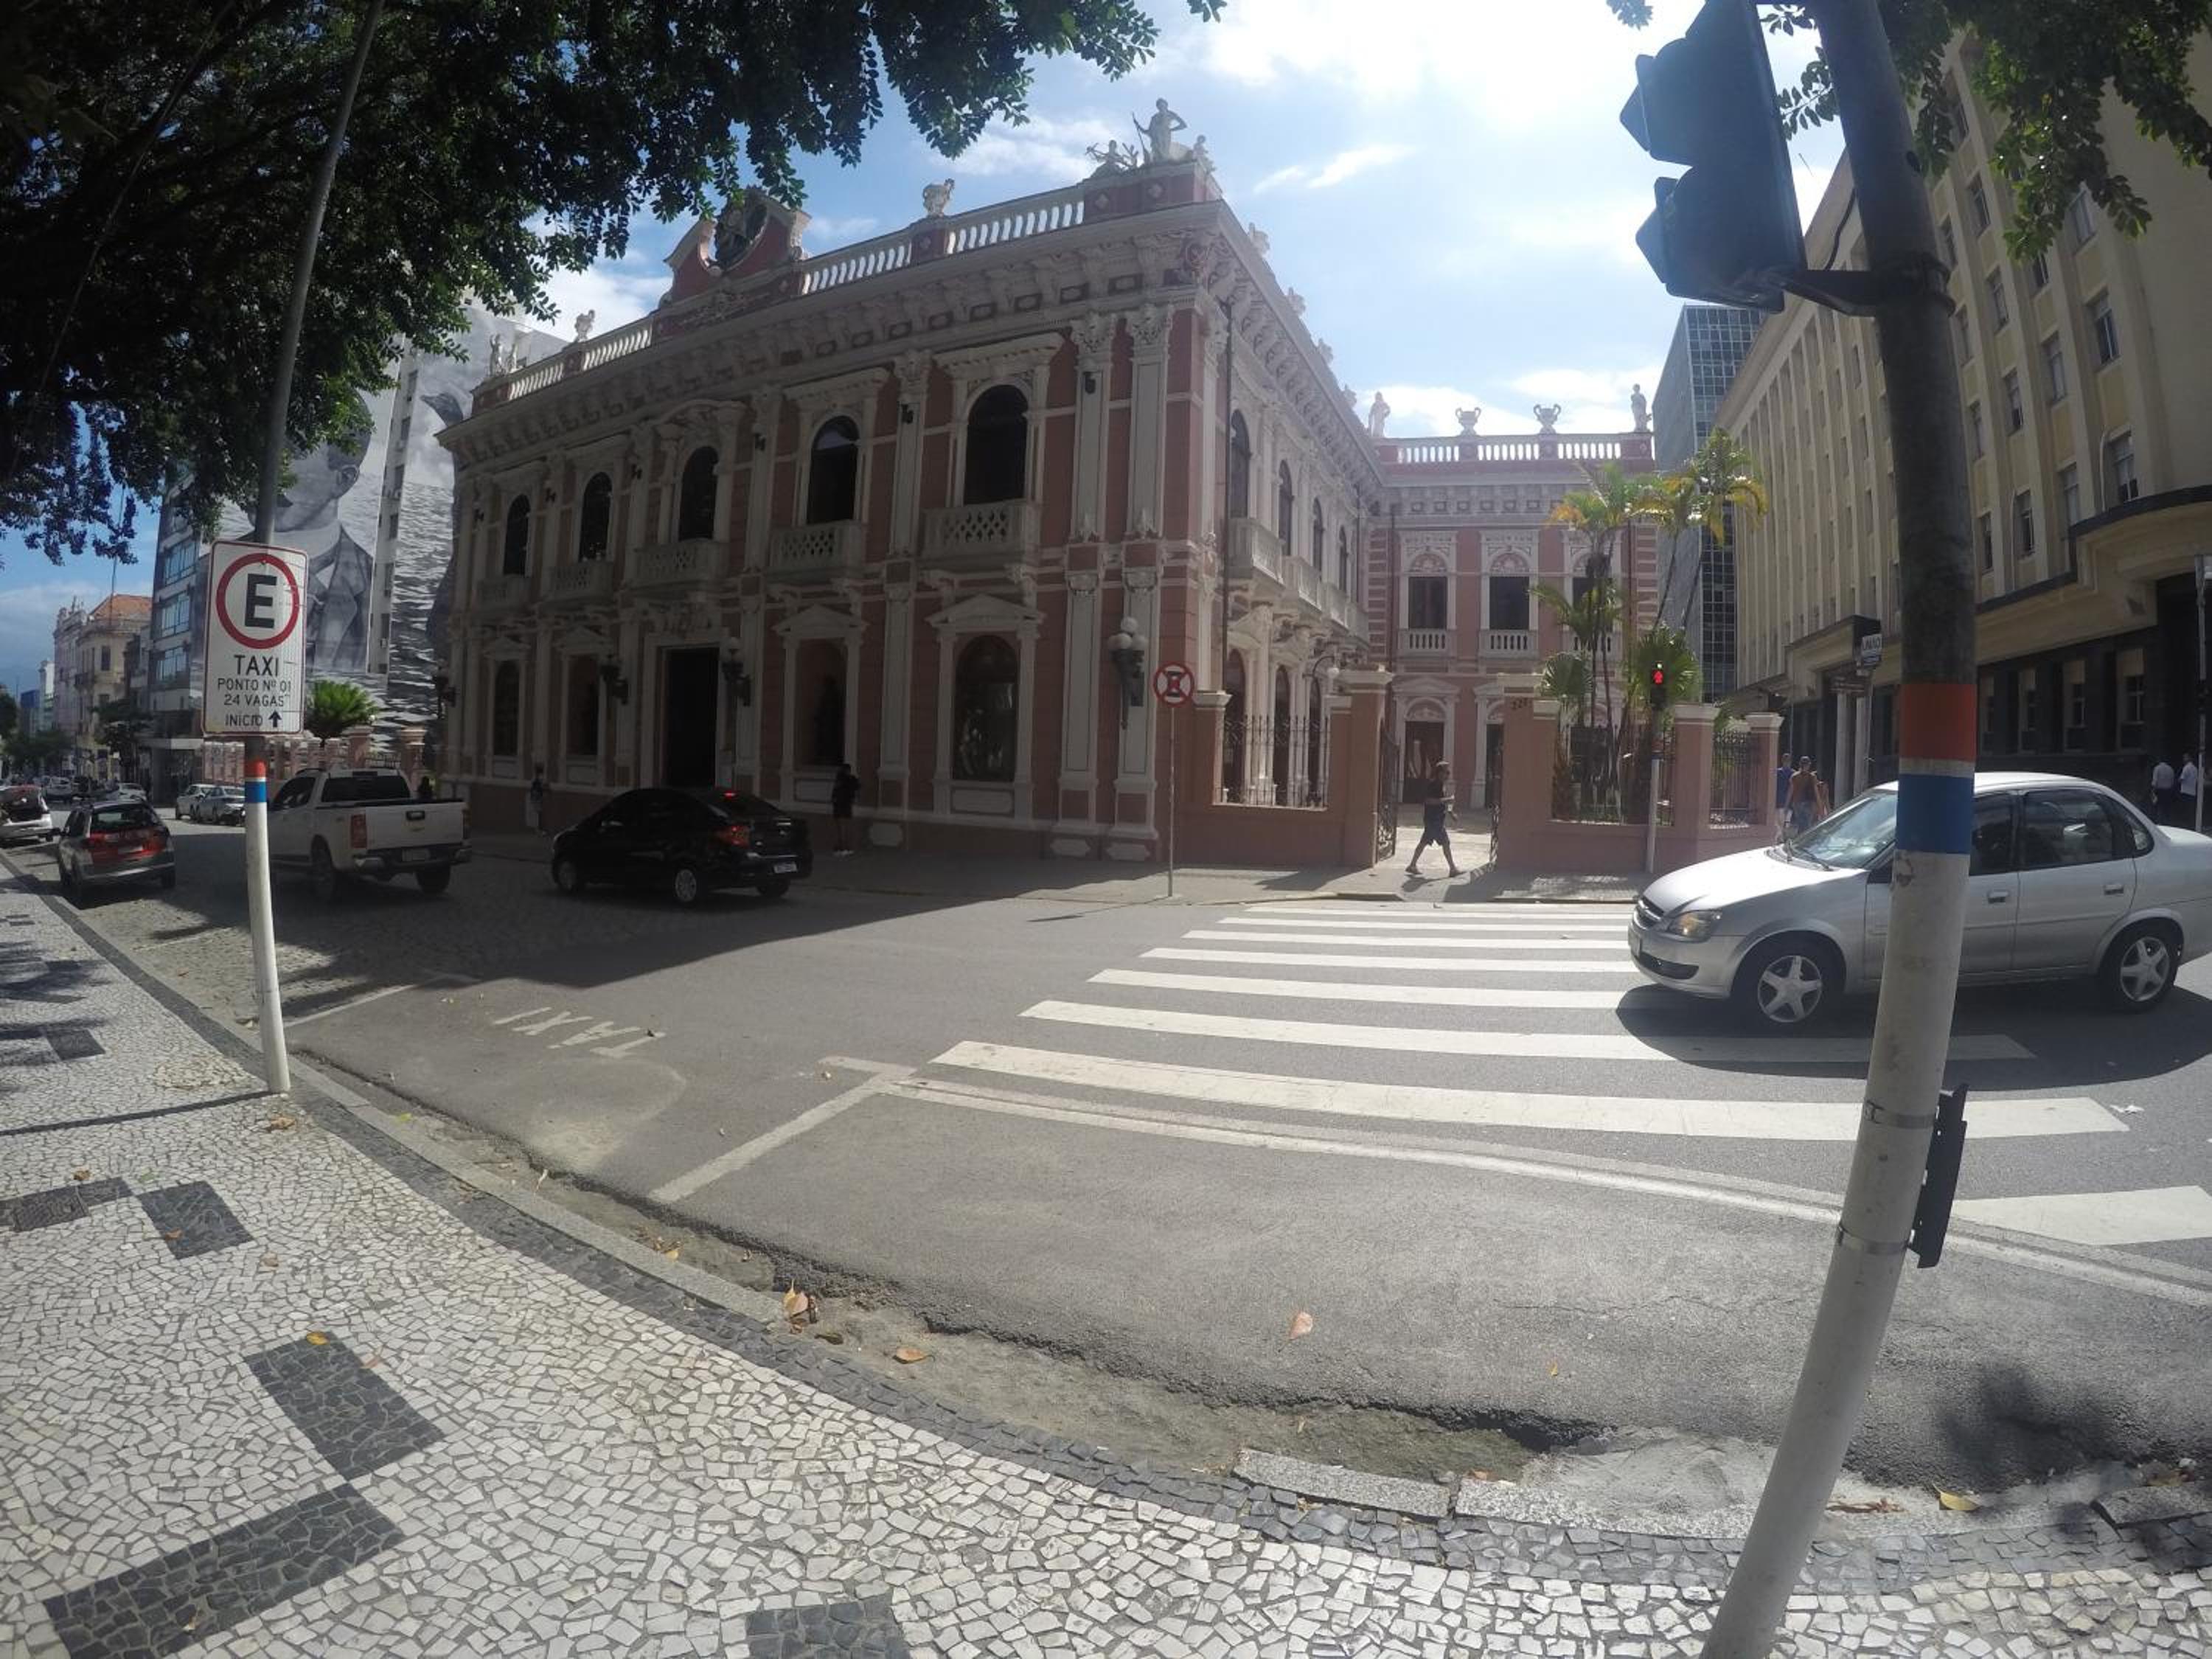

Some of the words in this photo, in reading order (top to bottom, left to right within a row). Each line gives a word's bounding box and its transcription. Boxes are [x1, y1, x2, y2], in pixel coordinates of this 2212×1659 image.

[245, 573, 277, 629] E
[234, 655, 279, 676] TAXI
[218, 678, 258, 692] PONTO
[280, 680, 291, 693] 01
[224, 694, 240, 706] 24
[244, 694, 285, 707] VAGAS
